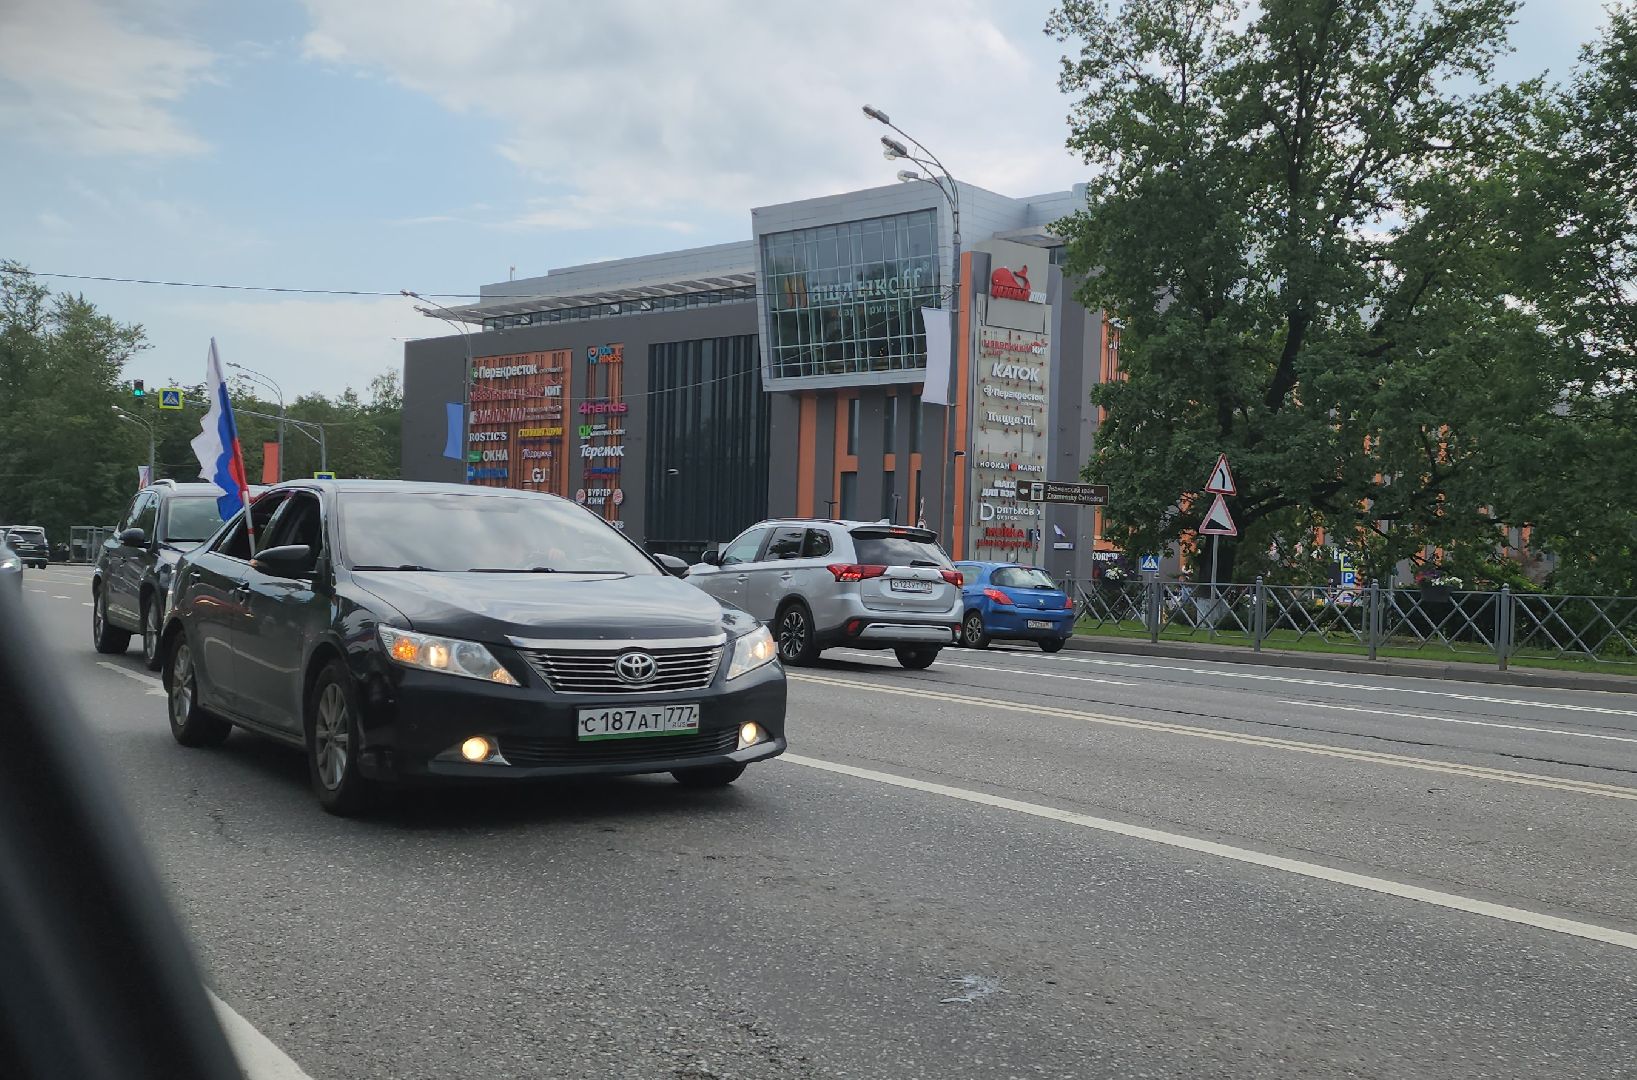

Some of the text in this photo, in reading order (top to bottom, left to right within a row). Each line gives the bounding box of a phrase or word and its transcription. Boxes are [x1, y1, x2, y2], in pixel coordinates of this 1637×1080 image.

[479, 364, 537, 380] Перекресток
[992, 362, 1040, 382] КАТОК
[544, 385, 562, 397] КИТ
[993, 387, 1046, 402] Перекресток
[577, 402, 627, 414] 4hands
[469, 431, 508, 442] ROSTIC'S
[482, 449, 509, 462] ОКНА
[580, 444, 625, 460] Теремок
[980, 461, 1045, 473] HOOKAH MARKET
[587, 488, 611, 497] БУРГЕР
[587, 496, 606, 505] КИНГ
[666, 706, 694, 723] 777
